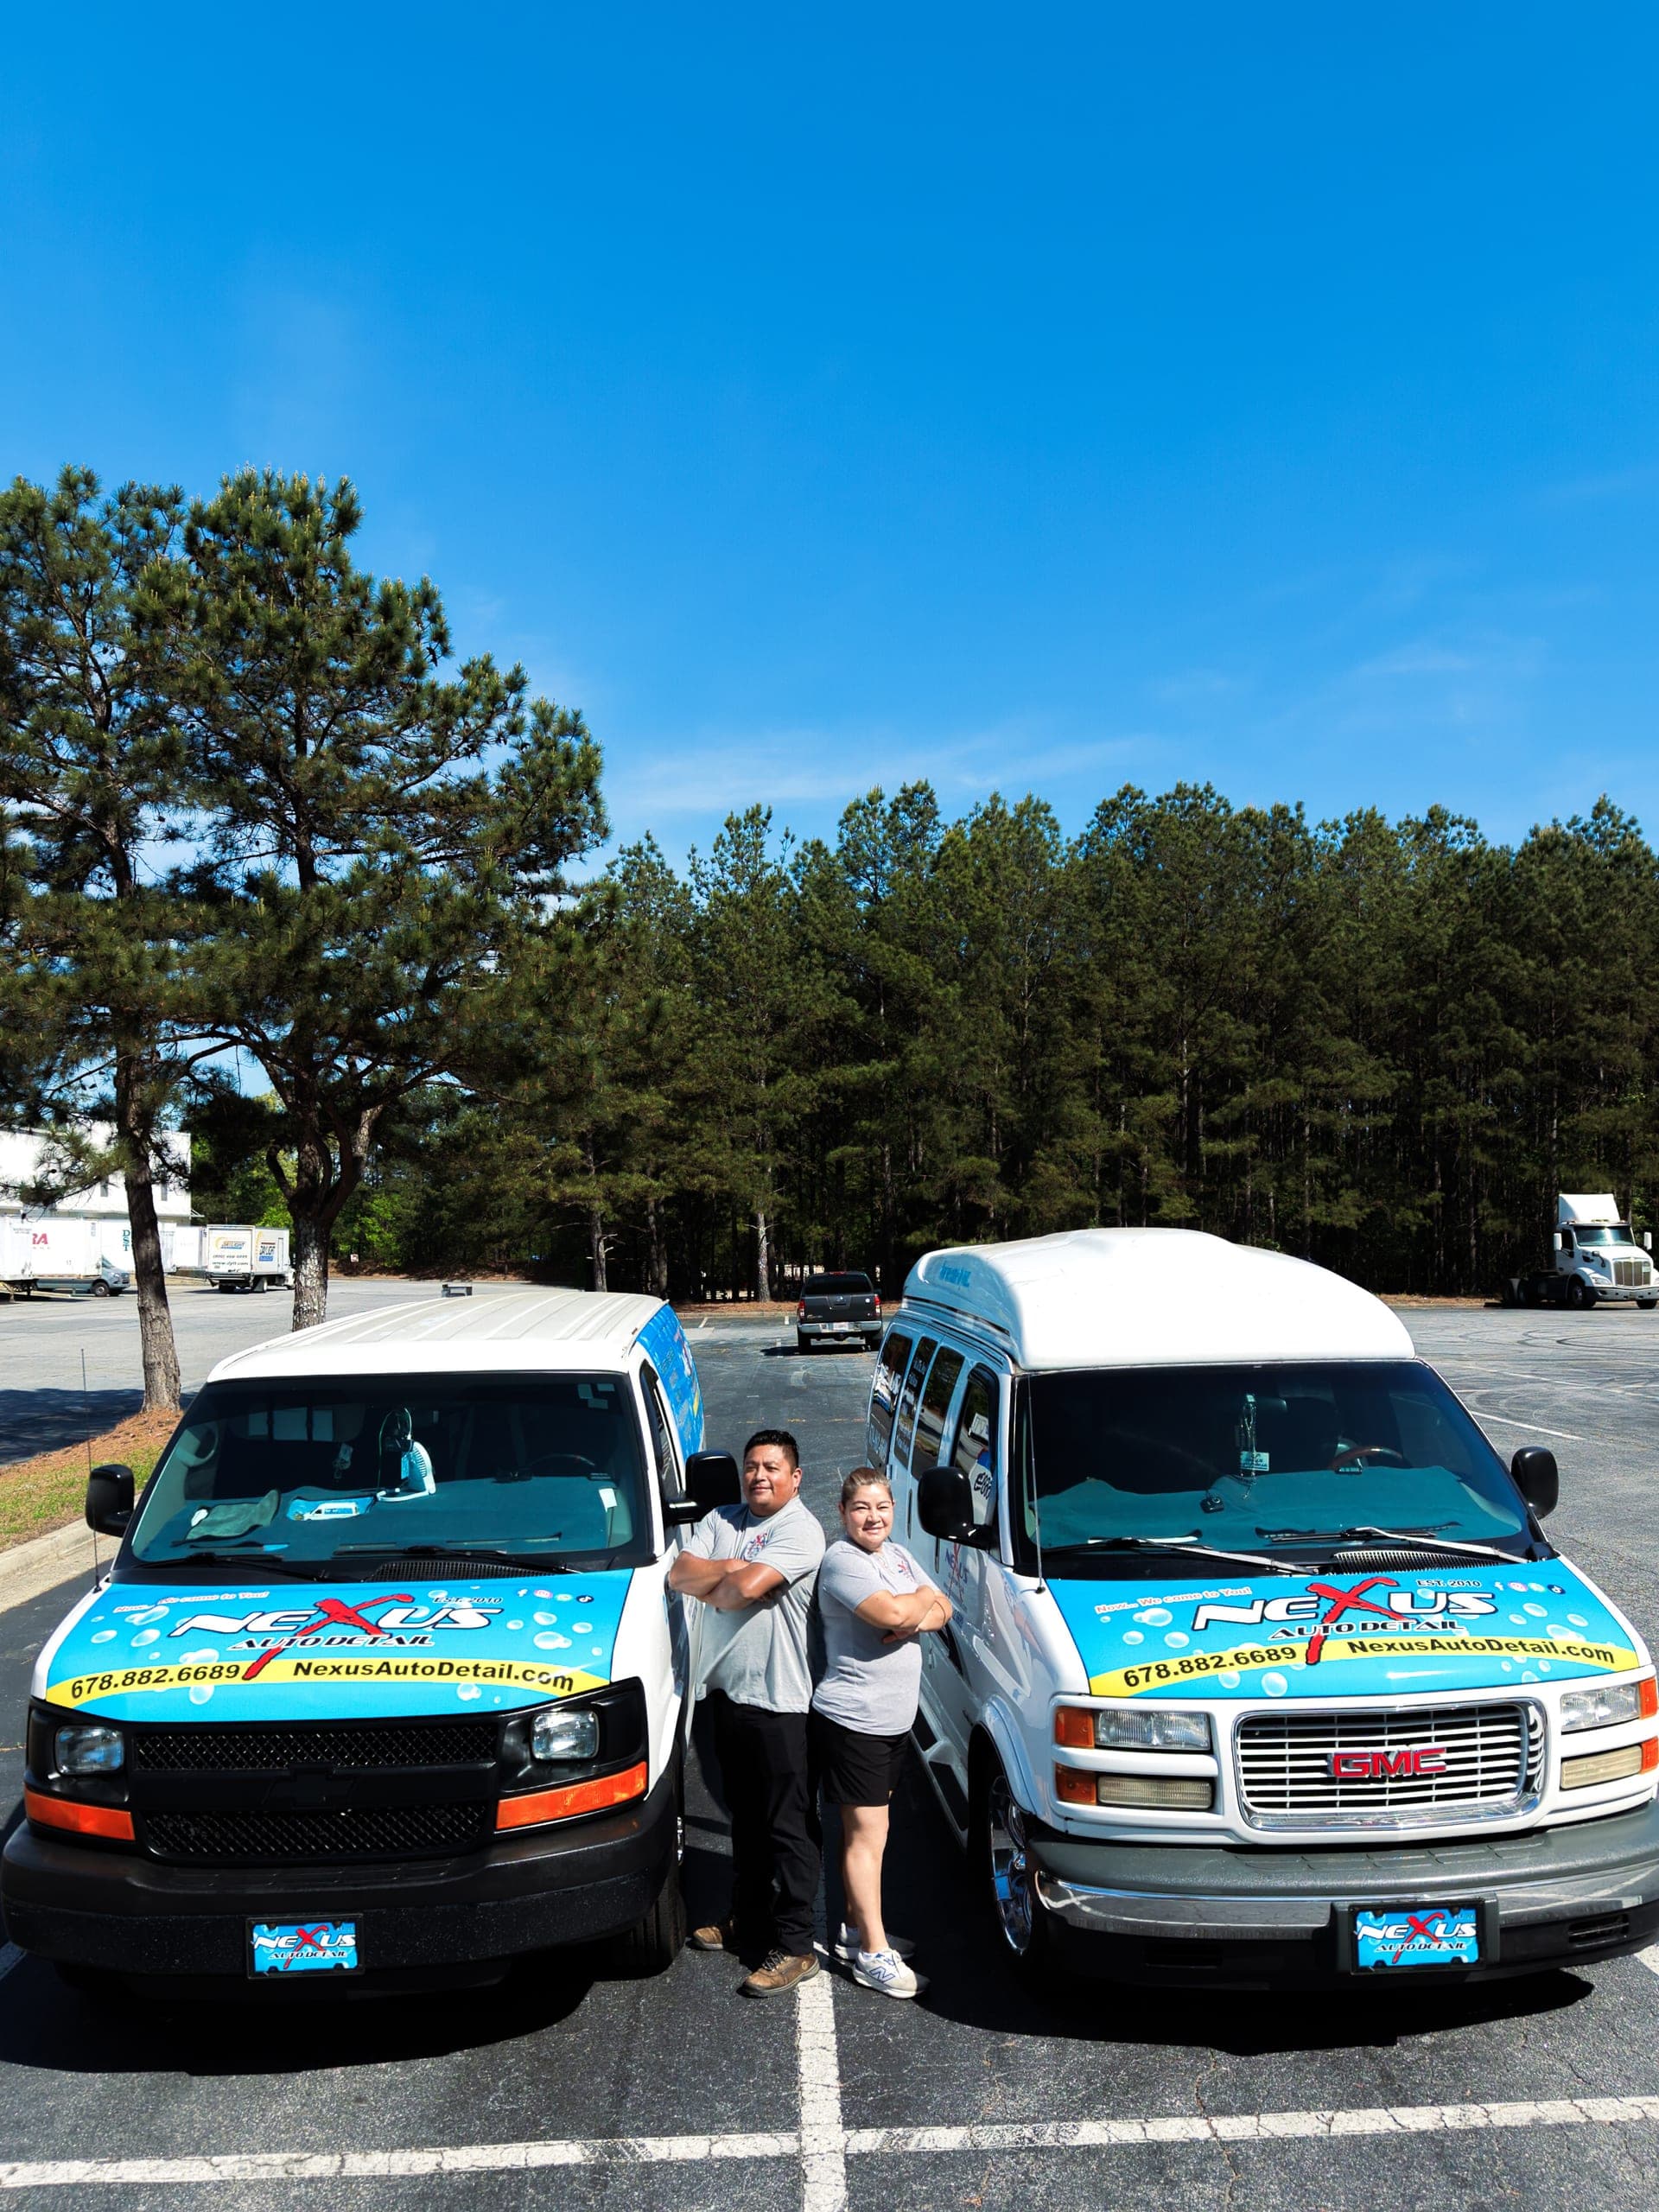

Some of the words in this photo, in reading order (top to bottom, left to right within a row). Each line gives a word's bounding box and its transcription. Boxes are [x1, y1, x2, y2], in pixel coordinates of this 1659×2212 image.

[1416, 1580, 1444, 1588] EST.
[1449, 1580, 1481, 1588] 2010
[1138, 1597, 1162, 1606] We
[1163, 1592, 1203, 1603] come
[1220, 1586, 1252, 1597] You!
[1269, 1623, 1355, 1640] AUTO
[1360, 1619, 1465, 1631] DETAIL
[228, 1635, 321, 1650] AUTO
[324, 1635, 434, 1647] DETAIL
[1347, 1638, 1615, 1663] NexusAutoDetail.com
[293, 1662, 575, 1691] NexusAutoDetail.com
[1123, 1646, 1297, 1687] 678.882.6689
[71, 1664, 240, 1699] 678.882.6689
[1333, 1747, 1446, 1778] GMC
[269, 1951, 303, 1960] AUTO
[305, 1950, 347, 1959] DETAIL
[1375, 1943, 1415, 1952] AUTO
[1417, 1942, 1466, 1951] DETAIL
